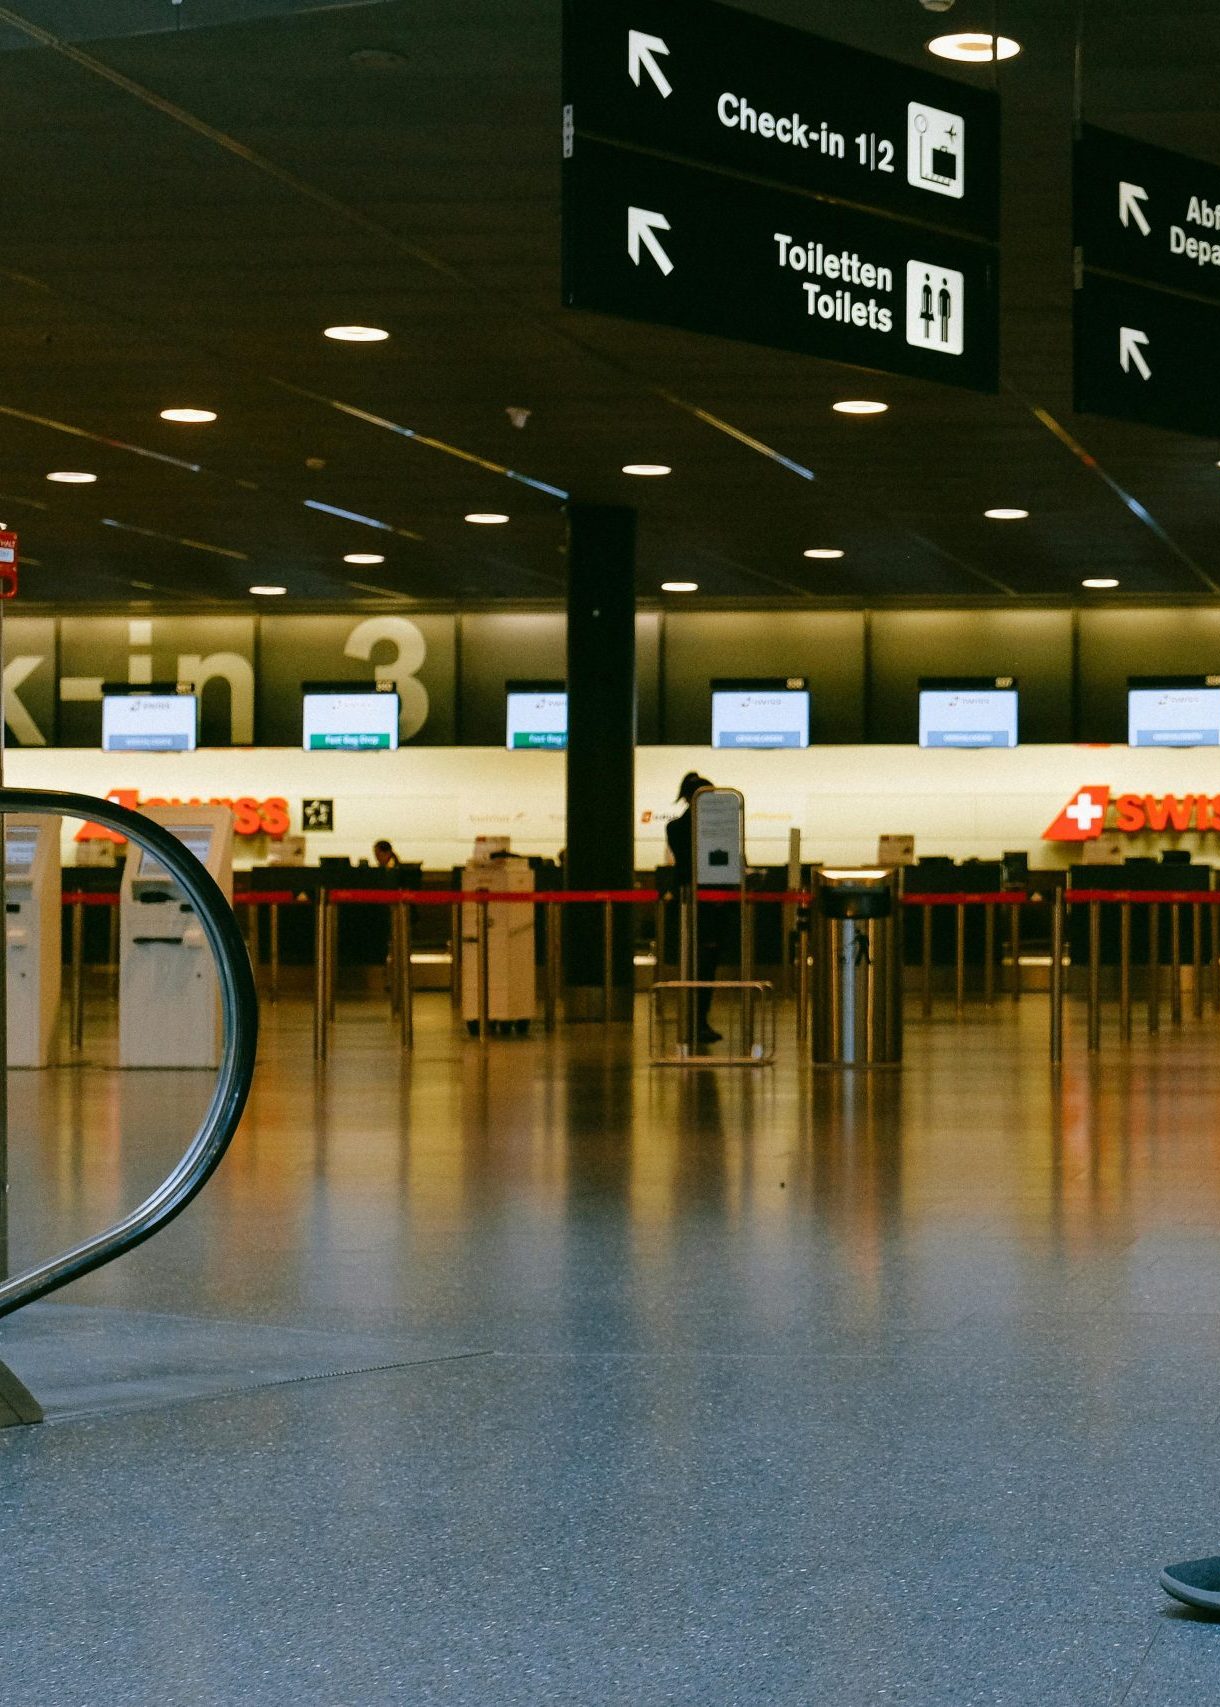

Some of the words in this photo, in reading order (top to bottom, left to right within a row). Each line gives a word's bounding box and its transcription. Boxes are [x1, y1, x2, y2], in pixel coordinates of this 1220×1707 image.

[717, 92, 845, 158] Check-in
[774, 233, 893, 292] Toiletten
[803, 282, 893, 333] Toilets
[344, 616, 429, 741] 3
